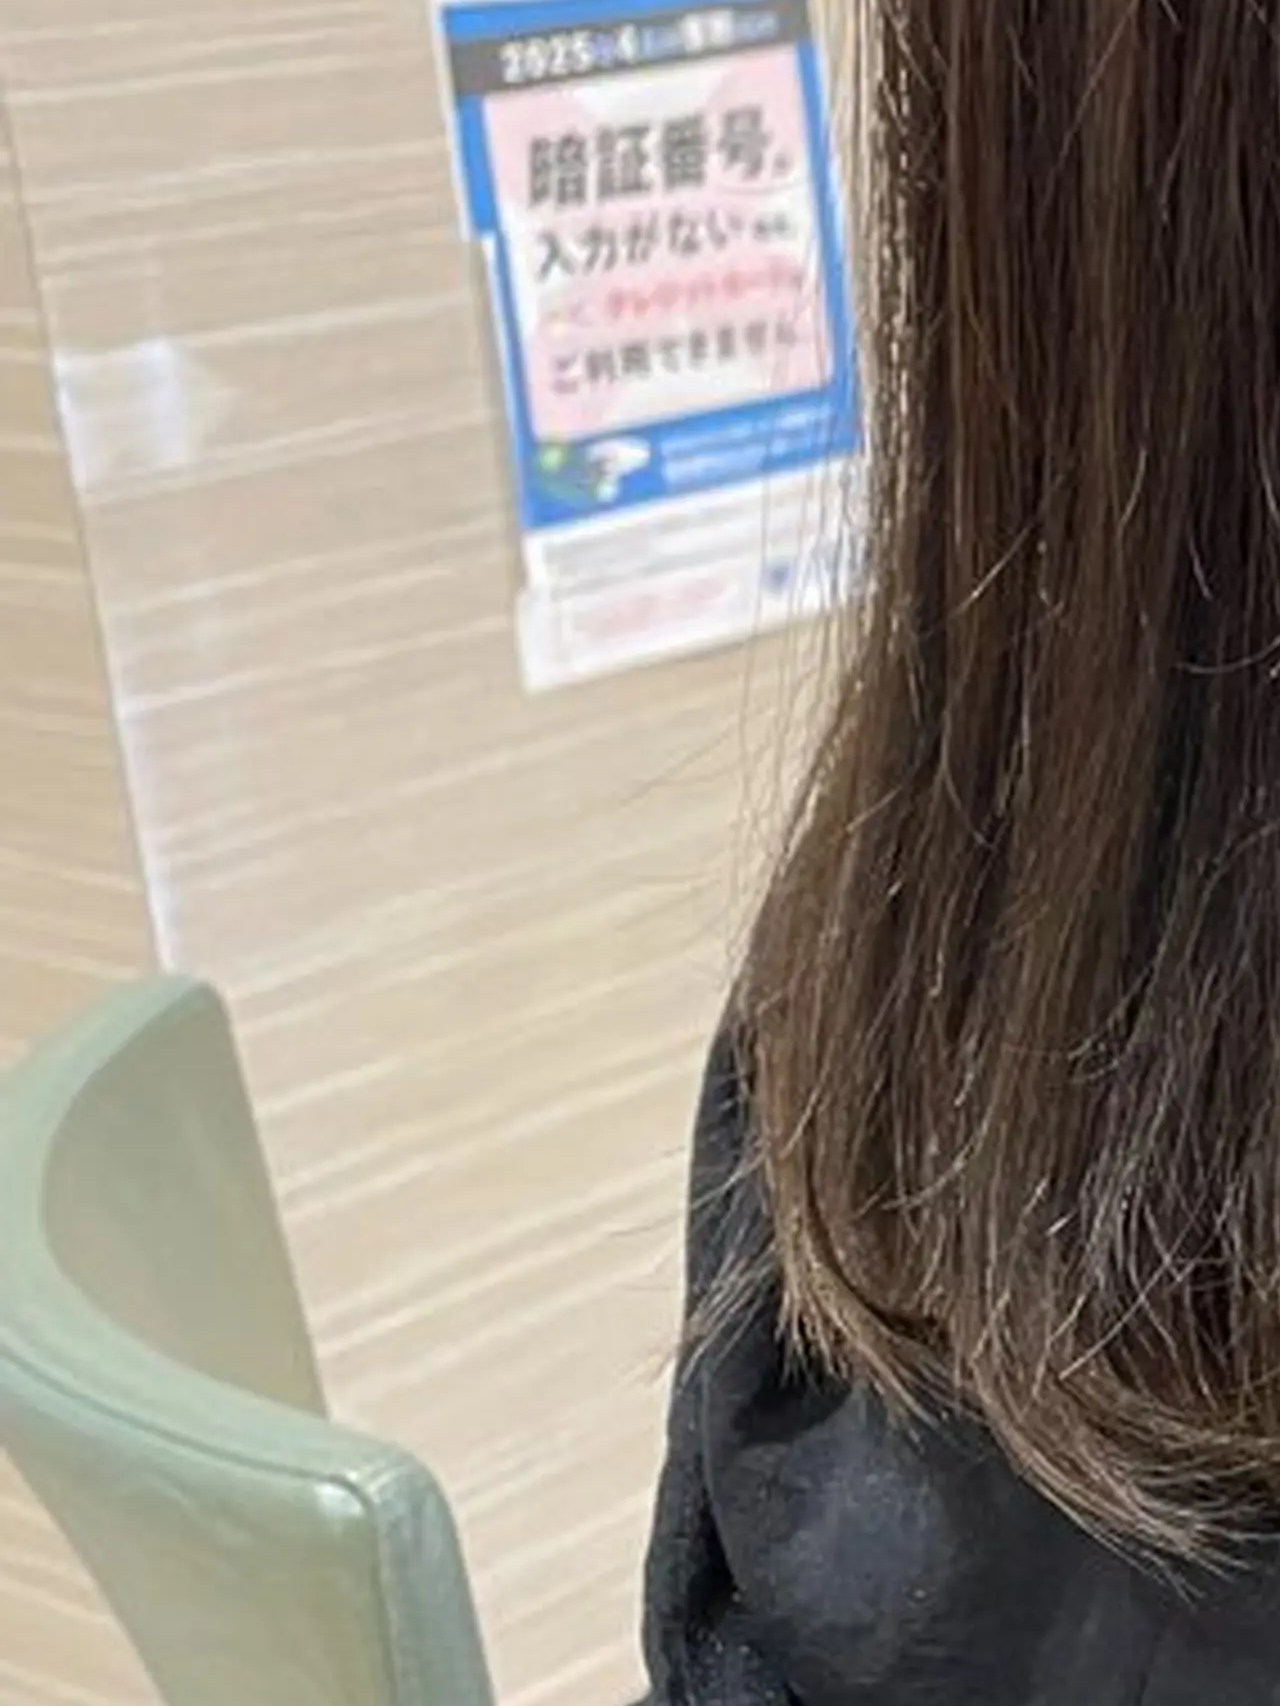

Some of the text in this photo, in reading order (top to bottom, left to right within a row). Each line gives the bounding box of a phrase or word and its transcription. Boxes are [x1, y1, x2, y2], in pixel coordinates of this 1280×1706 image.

[537, 208, 790, 281] 入力がない
